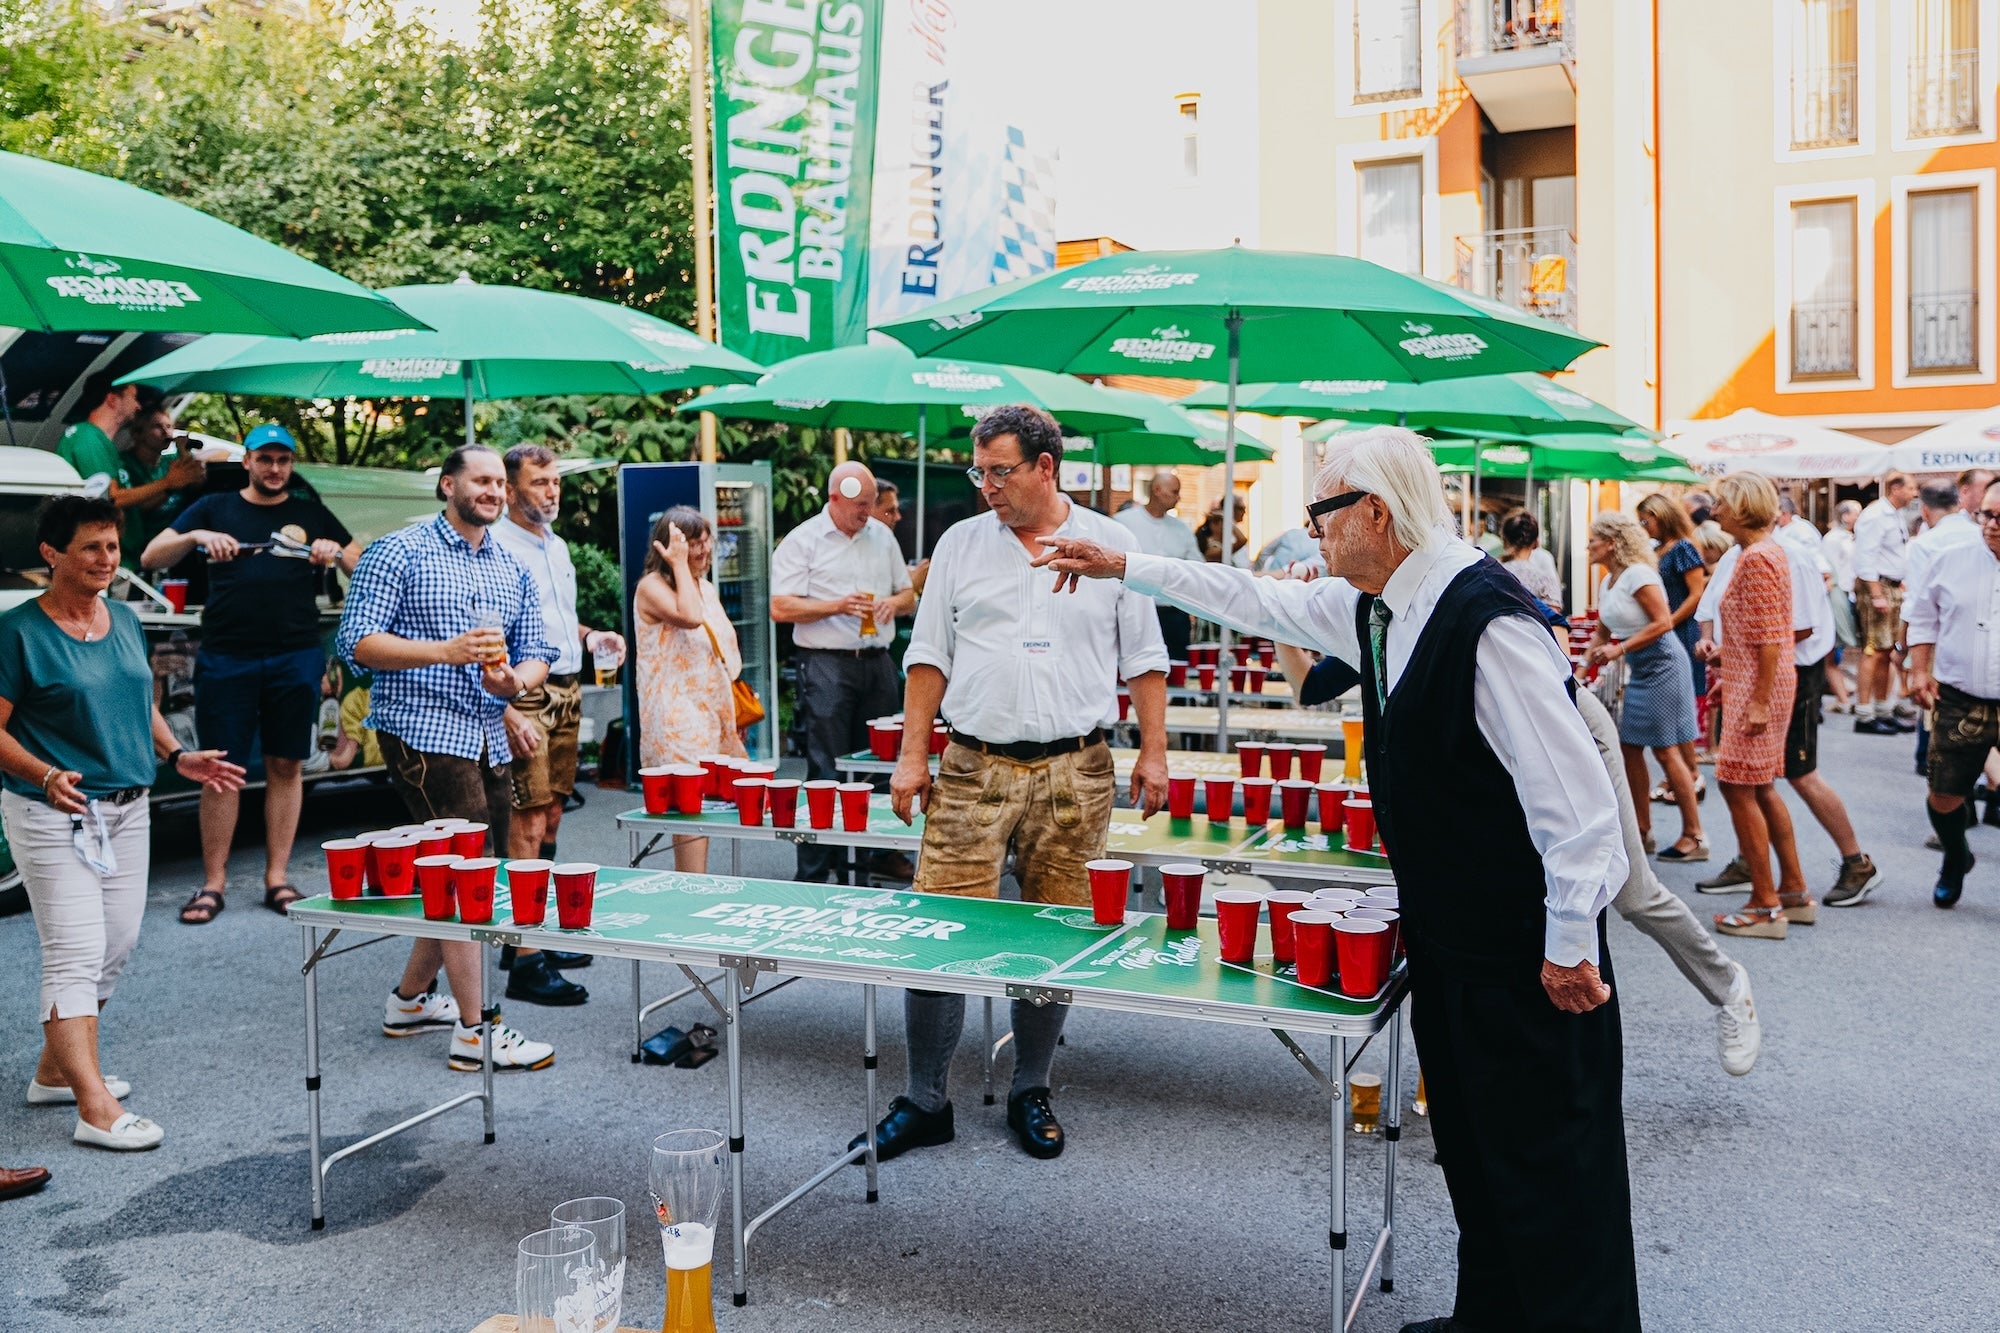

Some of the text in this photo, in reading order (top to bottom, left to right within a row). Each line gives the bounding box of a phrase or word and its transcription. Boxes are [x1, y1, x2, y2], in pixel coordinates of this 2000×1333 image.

[799, 3, 864, 282] BRAUHAUS
[901, 79, 949, 297] ERDINGER
[1060, 273, 1200, 289] ERDINGER
[689, 902, 966, 941] ERDINGER
[714, 917, 903, 942] BRAUHAUS
[748, 929, 838, 943] BARN
